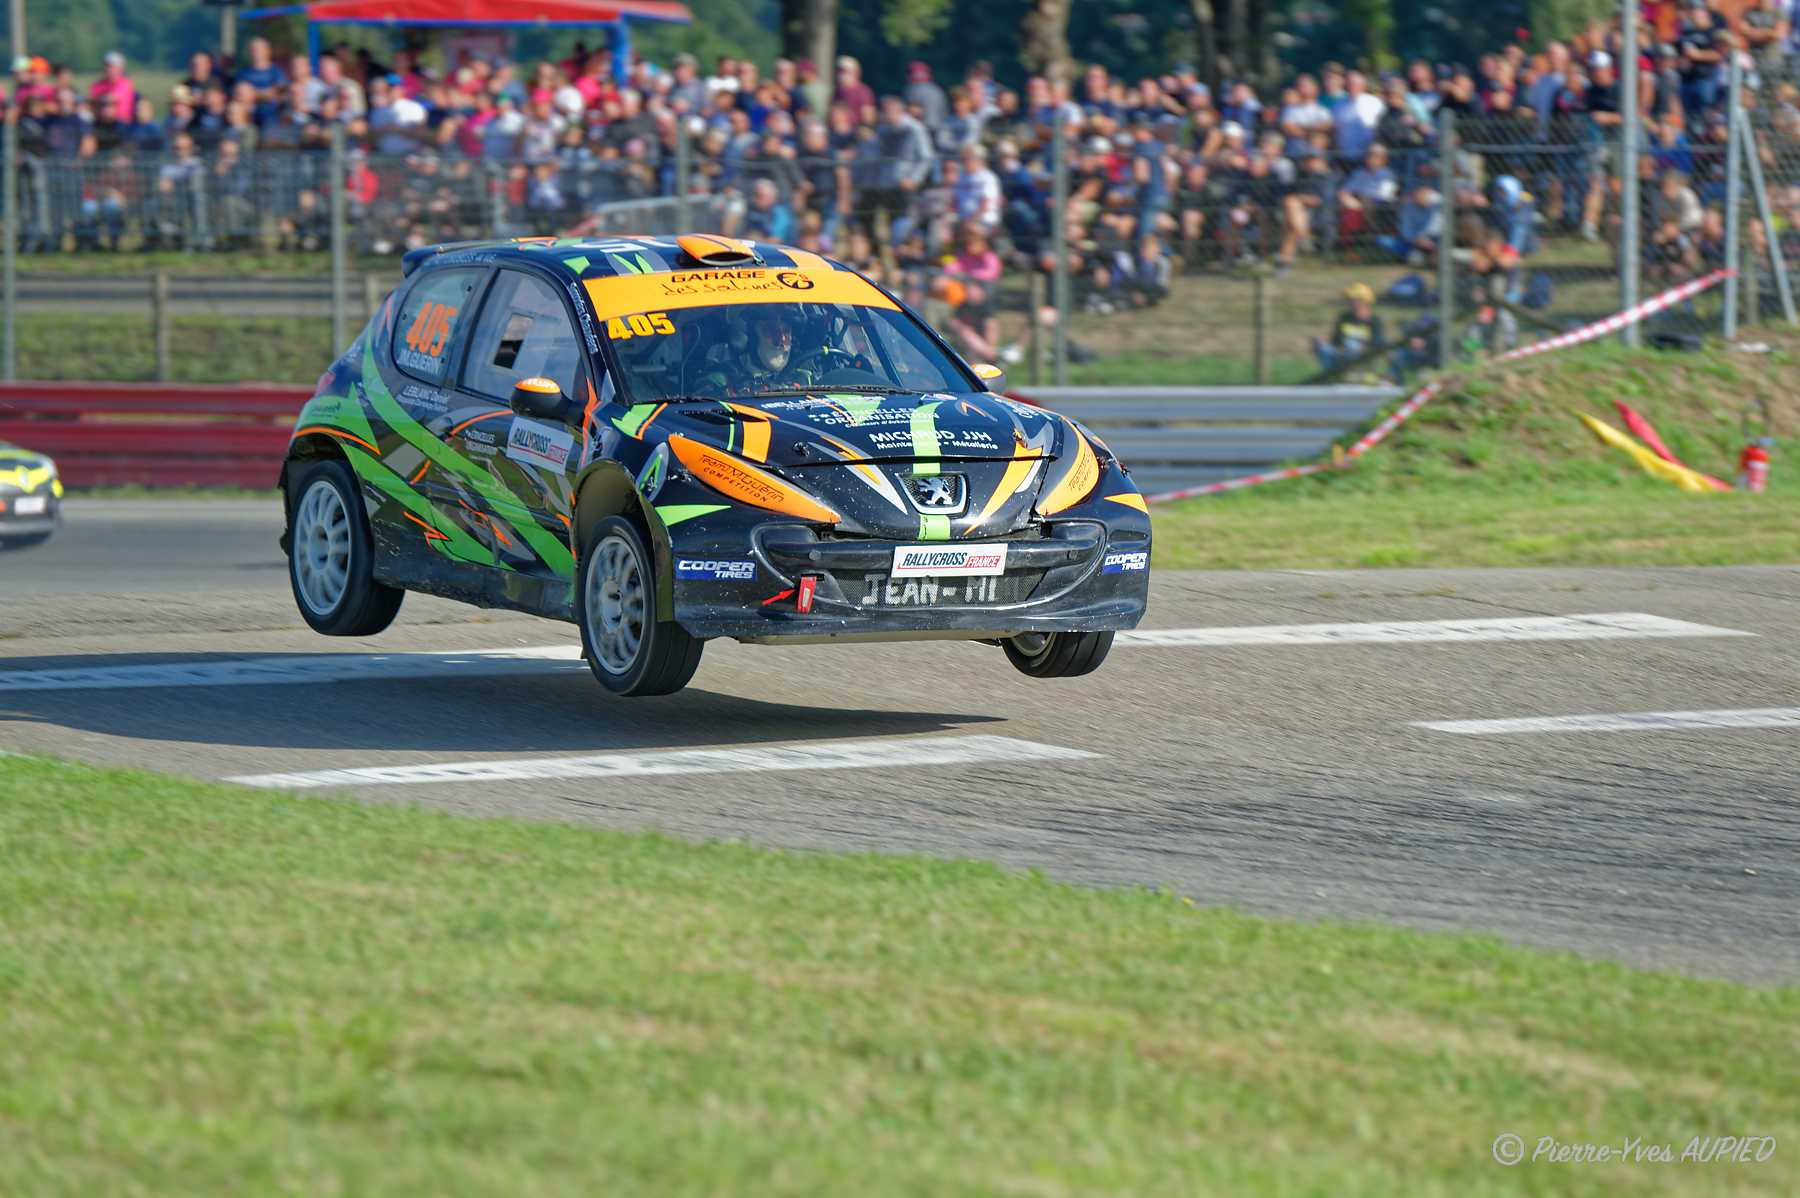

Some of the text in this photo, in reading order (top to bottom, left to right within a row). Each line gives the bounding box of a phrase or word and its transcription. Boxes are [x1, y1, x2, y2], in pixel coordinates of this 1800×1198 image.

[671, 270, 766, 283] GARAGE
[407, 301, 457, 357] 405
[608, 312, 676, 341] 405
[704, 468, 768, 502] COMPETITION
[678, 559, 755, 571] COOPER
[902, 552, 1000, 568] RALLYCROSS FRANCE
[1104, 552, 1147, 566] COOPER
[1121, 562, 1146, 572] TIRES
[714, 570, 753, 579] TIRES
